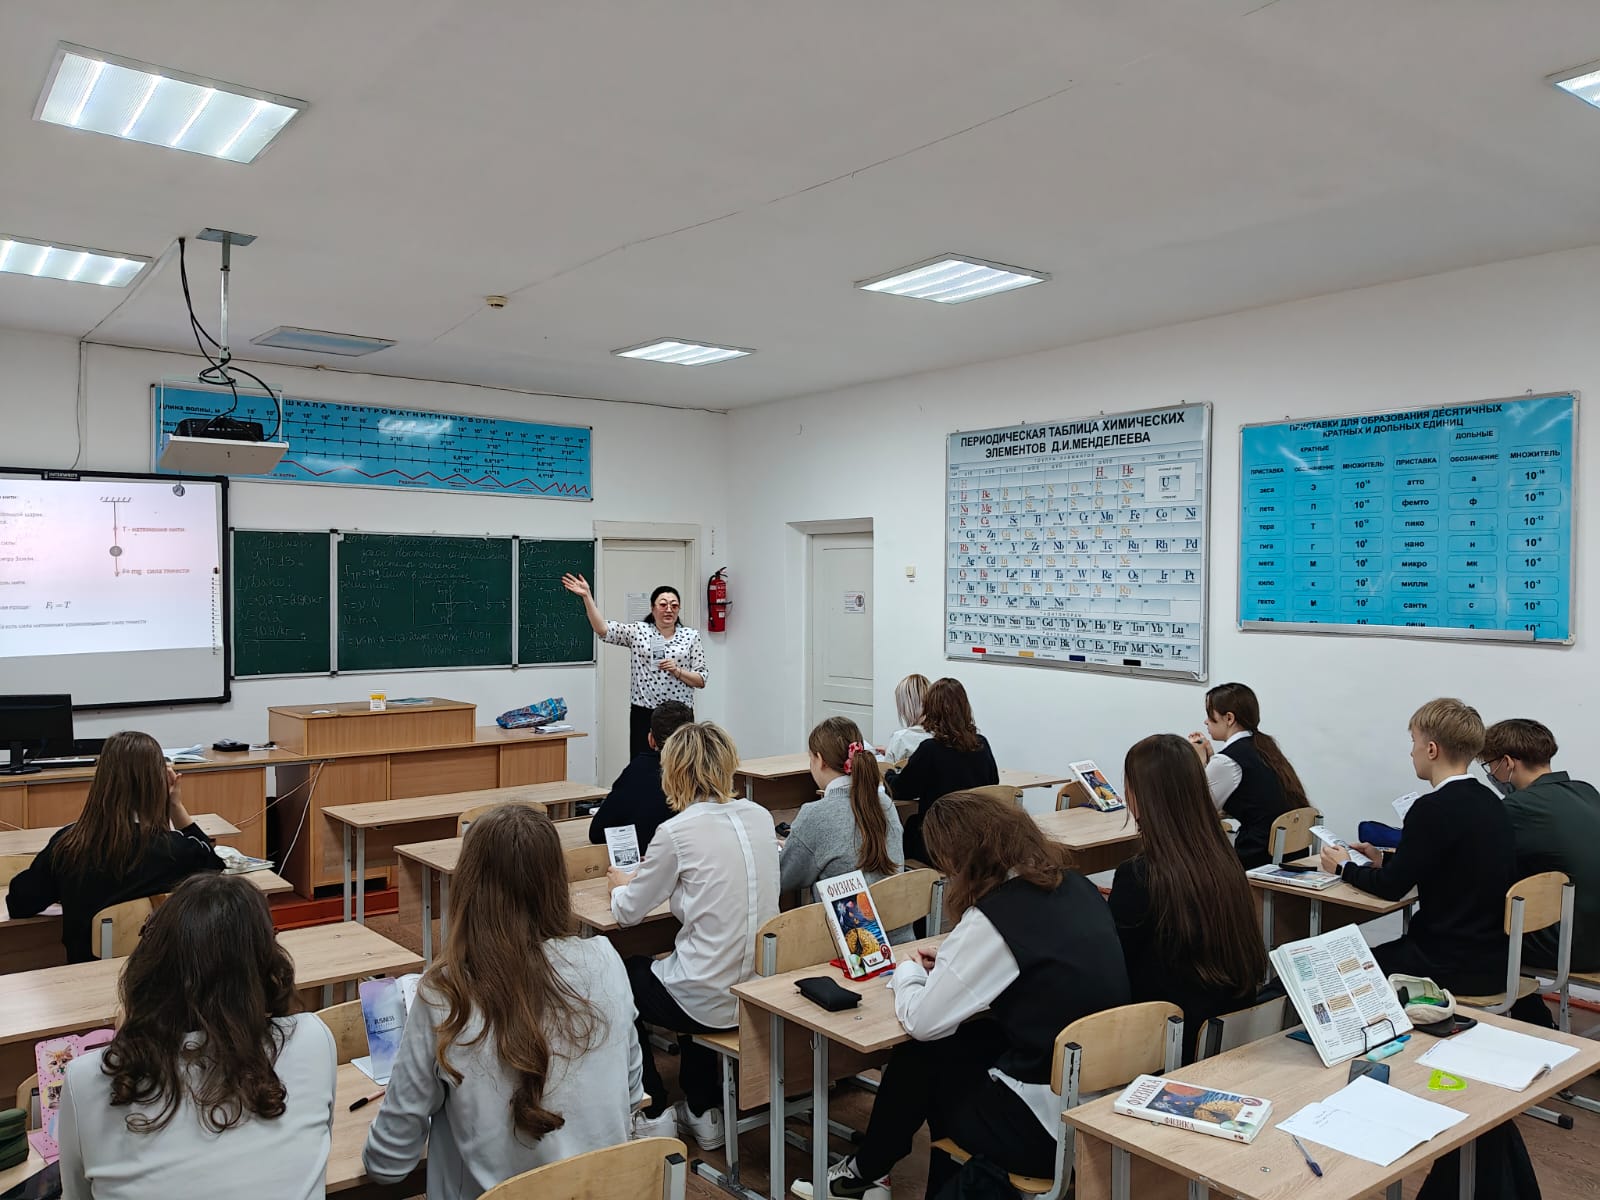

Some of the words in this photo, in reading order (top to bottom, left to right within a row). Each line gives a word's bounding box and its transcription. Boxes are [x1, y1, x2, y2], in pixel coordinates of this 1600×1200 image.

[285, 400, 326, 408] ШКАЛА
[336, 404, 464, 422] ЭЛЕКТРОМАГНИТНЫХ
[1340, 418, 1359, 428] ДЛЯ
[1362, 411, 1430, 425] ОБРАЗОВАНИЯ
[1432, 404, 1502, 418] ДЕСЯТИЧНЫХ
[960, 428, 1046, 448] ПЕРИОДИЧЕСКАЯ
[1049, 421, 1099, 438] ТАБЛИЦА
[1102, 412, 1185, 432] ХИМИЧЕСКИХ
[1323, 428, 1362, 438] КРАТНЫХ
[1374, 422, 1420, 435] ДОЛЬНЫХ
[1423, 418, 1464, 429] ЕДИНИЦ
[1456, 430, 1494, 440] ДОЛЬНЫЕ
[986, 443, 1046, 458] ЭЛЕМЕНТОВ
[1051, 432, 1150, 454] Д.И.МЕНДЕЛЕЕВА
[1396, 457, 1438, 466] ПРИСТАВКА
[1450, 454, 1498, 463] ОБОЗНАЧЕНИЕ
[1510, 450, 1560, 459] МНОЖИТЕЛЬ
[1096, 466, 1104, 476] H
[1122, 465, 1134, 474] He
[1162, 478, 1170, 488] U
[1402, 500, 1429, 508] фемто
[1470, 498, 1478, 506] ф
[1130, 510, 1140, 520] Fe
[1156, 509, 1168, 518] Co
[1186, 508, 1196, 517] Ni
[1128, 540, 1140, 550] Ru
[1156, 540, 1168, 550] Rh
[1185, 538, 1198, 549] Pd
[1128, 570, 1139, 580] Os
[1184, 570, 1195, 580] Pt
[1094, 620, 1106, 630] Ho
[1112, 620, 1123, 631] Er
[1151, 623, 1164, 633] Yb
[1172, 624, 1184, 634] Lu
[1131, 642, 1145, 653] Md
[1150, 644, 1163, 654] No
[1171, 645, 1182, 656] Lr
[827, 878, 864, 898] ФИЗИКА
[1127, 1080, 1162, 1106] ФИЗИКА
[1164, 1116, 1196, 1132] ФИЗИКА
